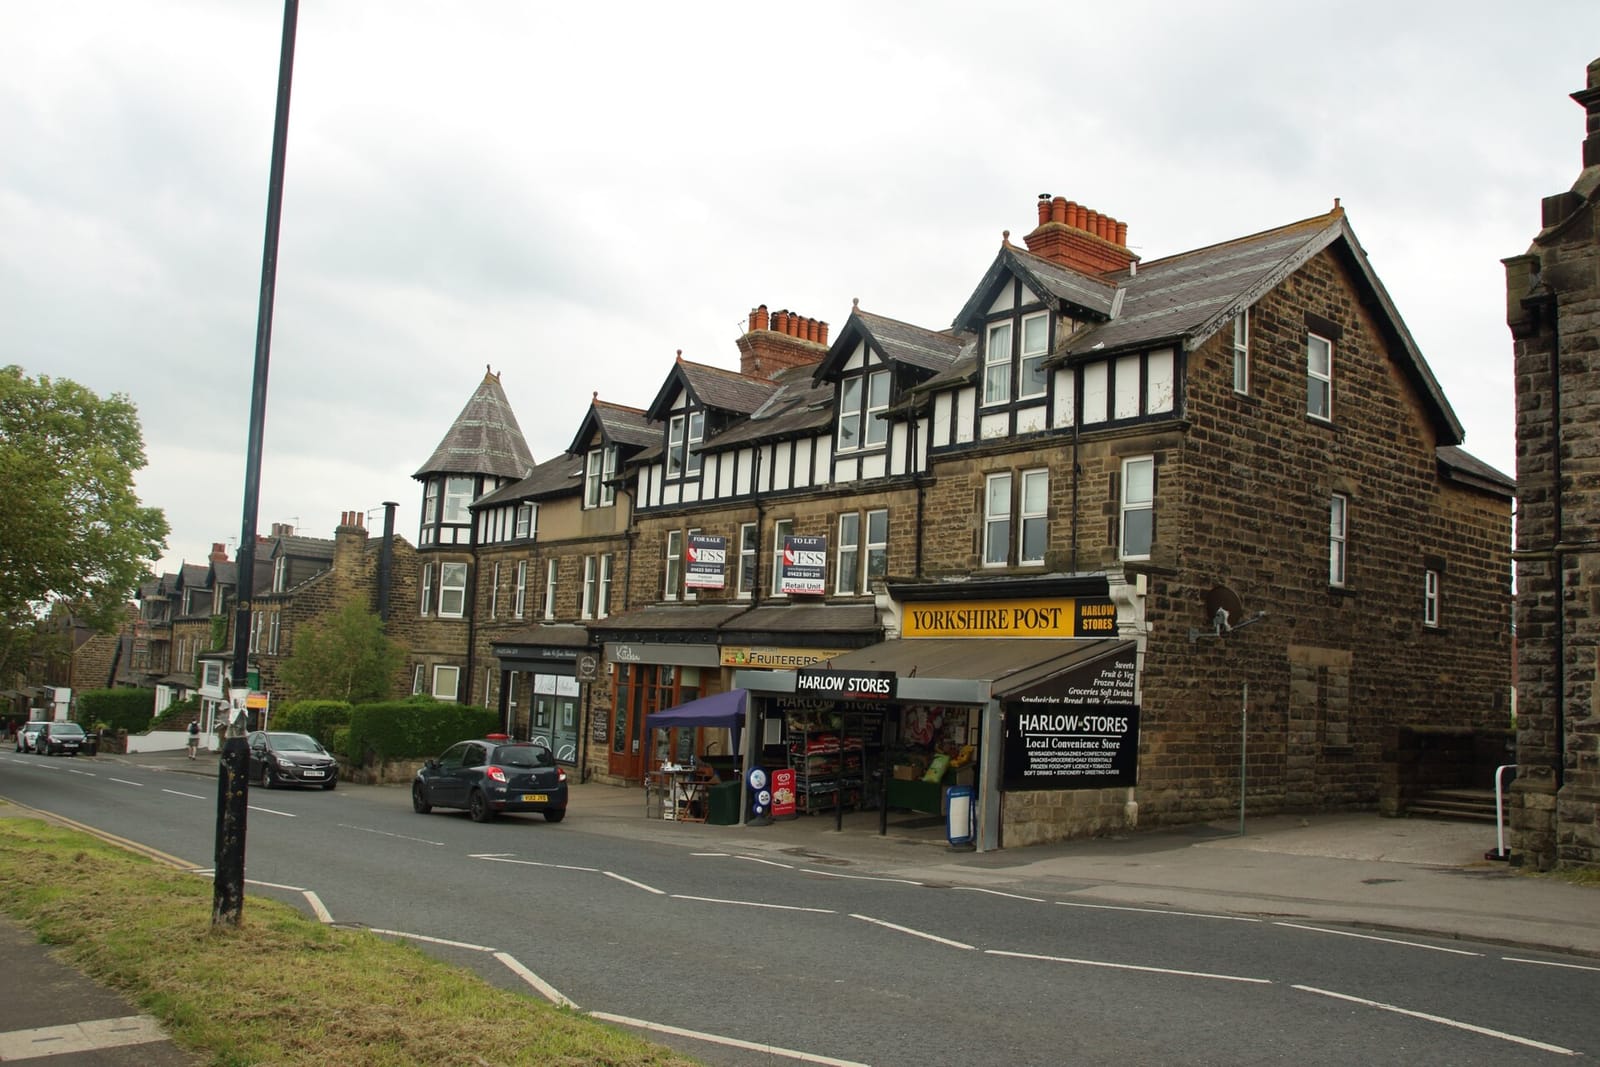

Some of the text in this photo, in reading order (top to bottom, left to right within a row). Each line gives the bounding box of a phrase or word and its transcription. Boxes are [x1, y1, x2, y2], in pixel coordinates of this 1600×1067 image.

[1081, 605, 1114, 616] HARLOW
[912, 607, 1062, 630] YORKSHIRE POST
[1082, 618, 1112, 630] STORES
[749, 652, 818, 666] FRUITERERS
[1115, 661, 1134, 669] Sweets
[1124, 671, 1134, 680] Veg
[798, 676, 890, 693] HARLOW STORES
[1068, 687, 1098, 696] Groceries
[1100, 689, 1111, 697] Soft
[1019, 714, 1128, 732] HARLOW STORES
[1026, 738, 1120, 749] Local Convenience Store
